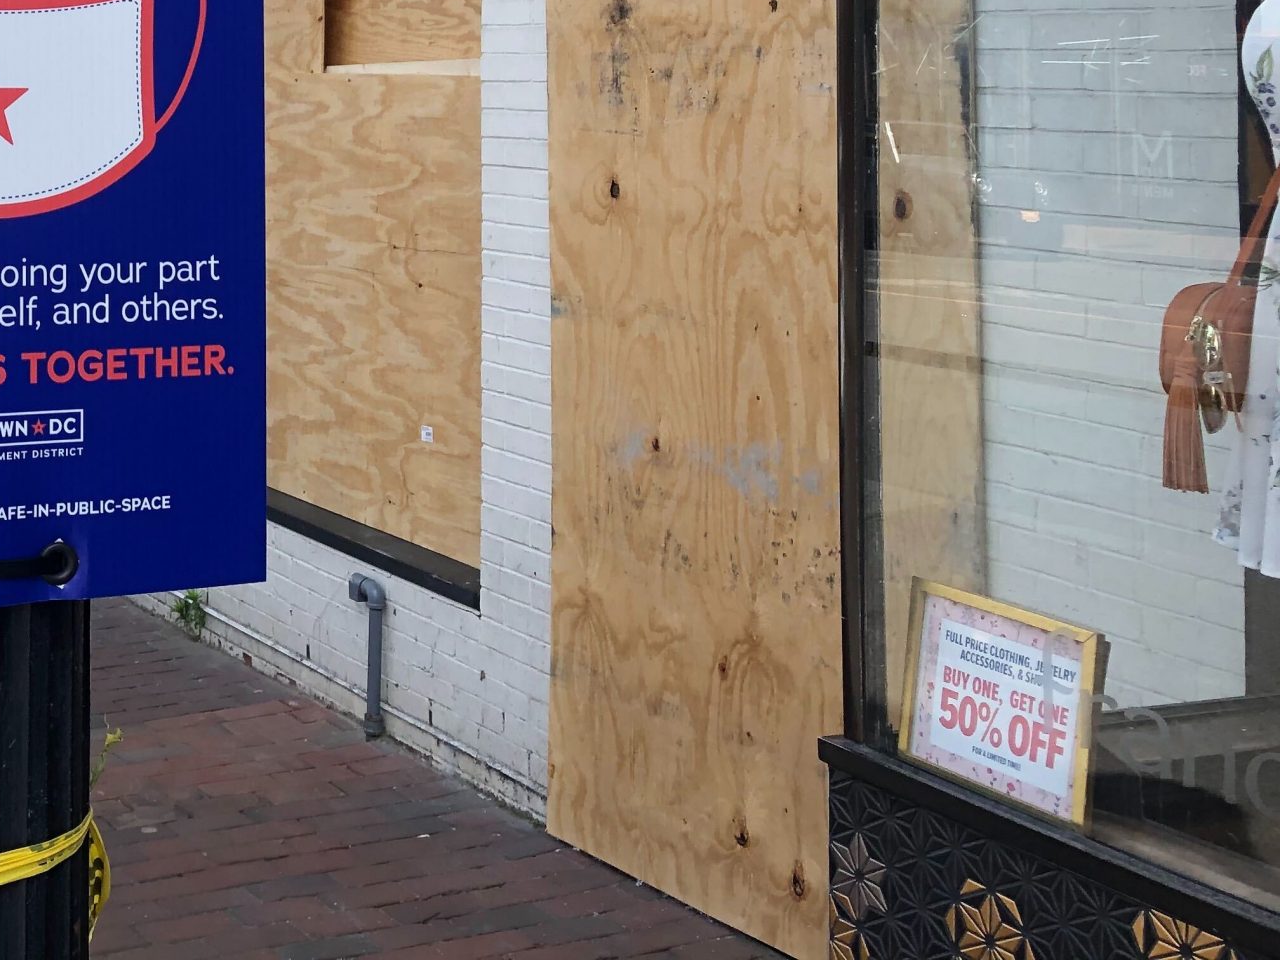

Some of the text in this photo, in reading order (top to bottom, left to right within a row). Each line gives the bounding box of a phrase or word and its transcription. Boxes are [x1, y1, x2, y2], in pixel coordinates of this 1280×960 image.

[80, 262, 146, 292] your
[160, 255, 219, 289] part
[53, 294, 109, 324] and
[122, 292, 223, 322] others.
[21, 345, 233, 383] TOGETHER.
[50, 418, 76, 434] DC
[33, 448, 83, 458] DISTRICT
[945, 629, 964, 646] FULL
[965, 637, 988, 654] PRICE
[1035, 659, 1077, 683] JEELRY
[960, 649, 1015, 680] ACCESSORIES,
[1017, 669, 1024, 681] &
[943, 665, 970, 690] BUY
[972, 677, 1003, 706] ONE,
[1010, 690, 1036, 714] GET
[938, 687, 1067, 770] 50% OFF
